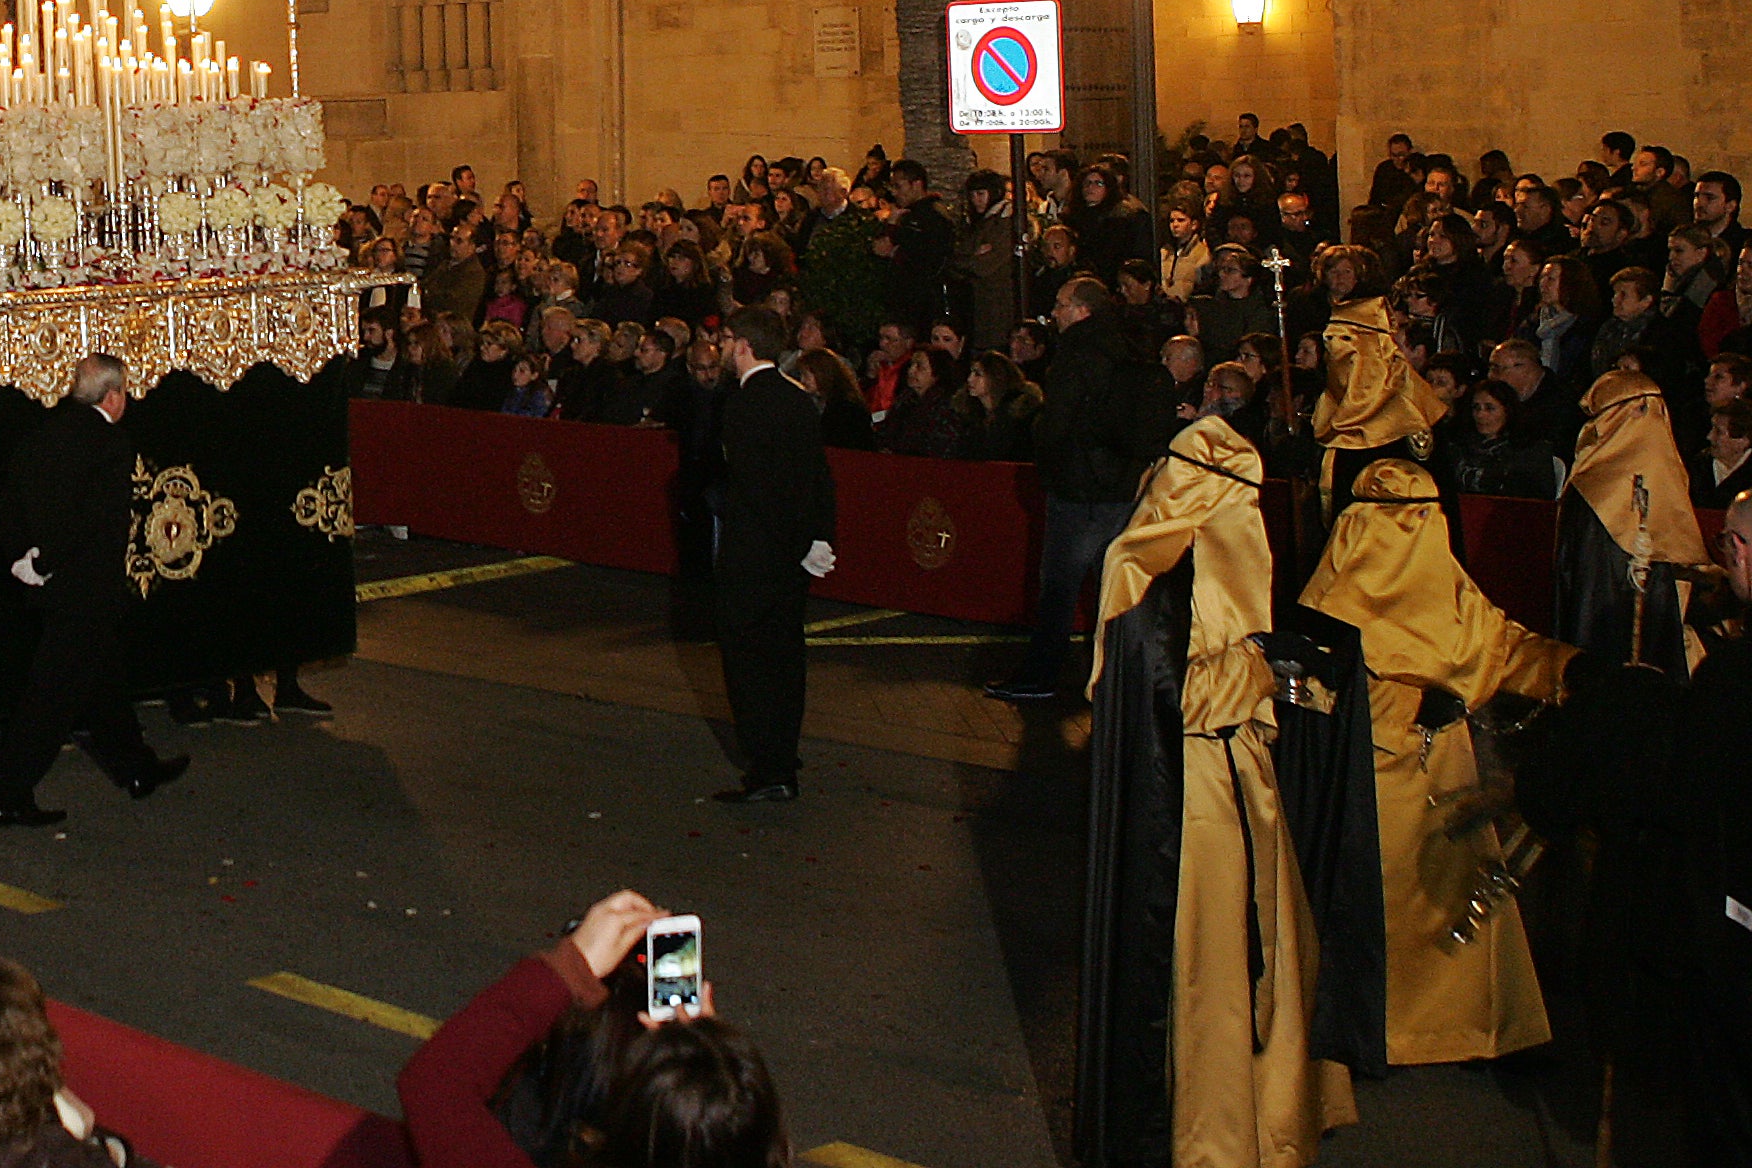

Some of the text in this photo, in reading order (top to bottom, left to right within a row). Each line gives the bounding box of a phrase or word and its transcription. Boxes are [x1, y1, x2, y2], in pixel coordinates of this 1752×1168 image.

[979, 5, 1020, 14] Excepto
[955, 17, 985, 25] carga
[1001, 14, 1050, 22] descarga
